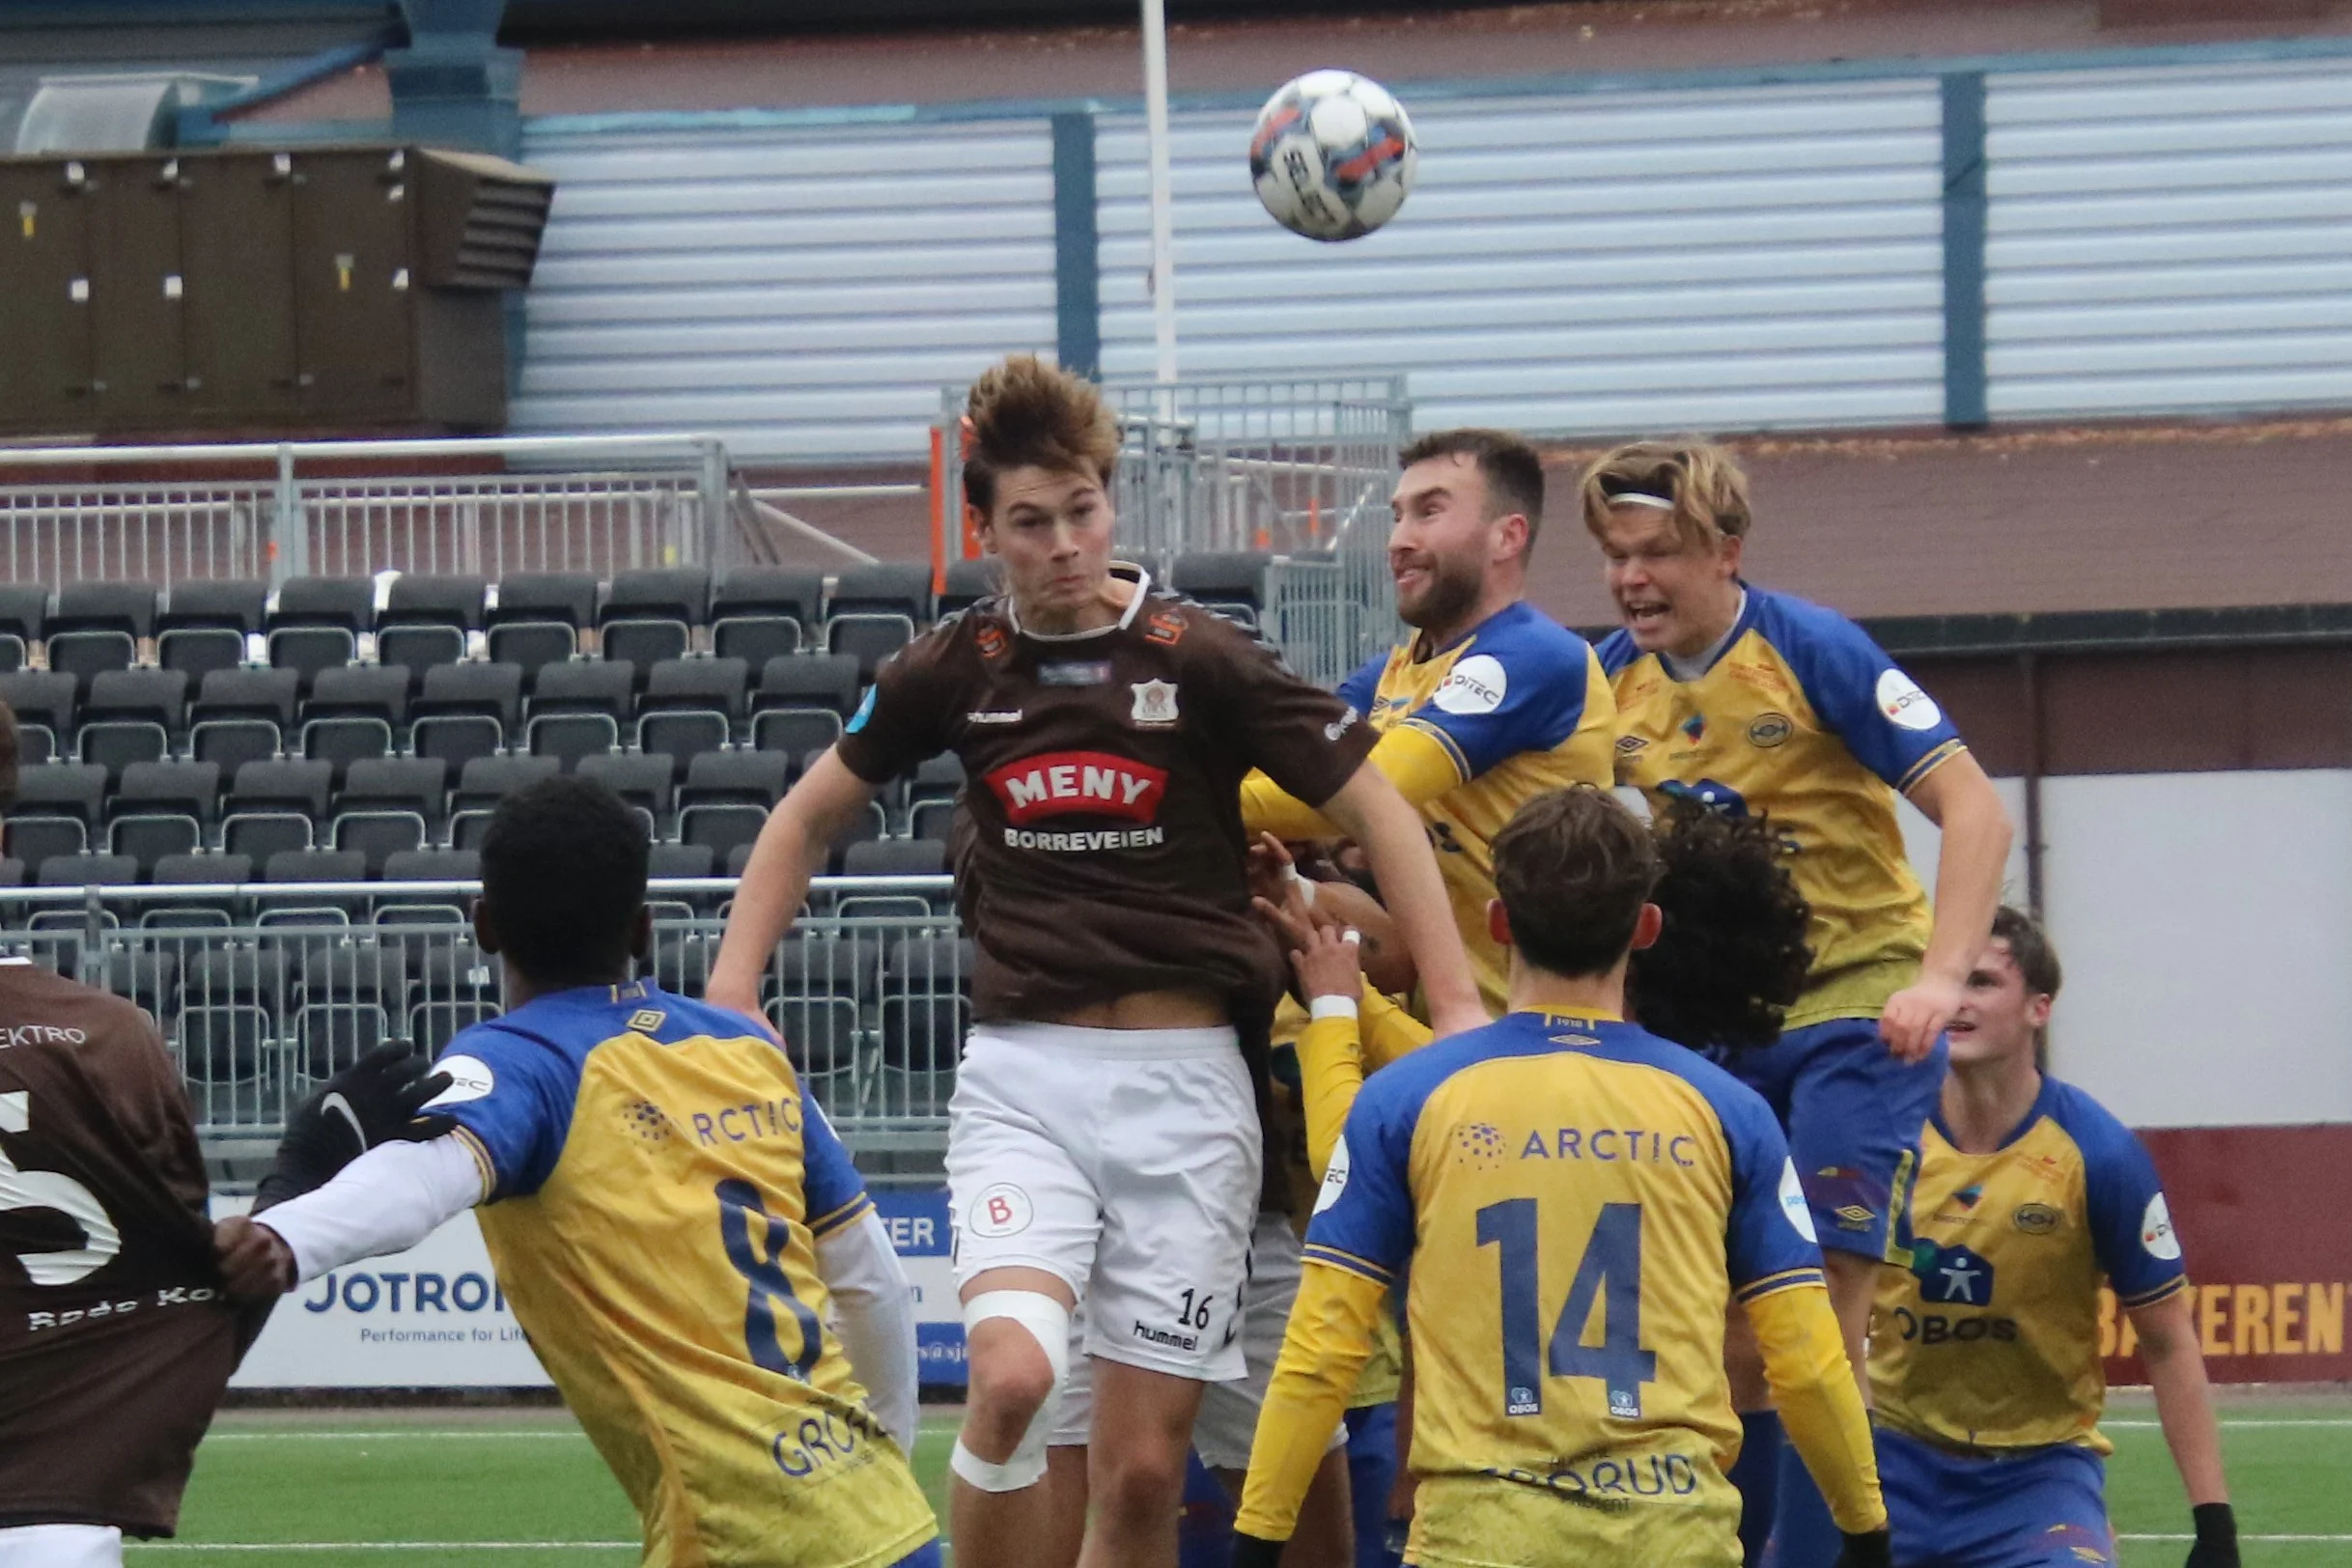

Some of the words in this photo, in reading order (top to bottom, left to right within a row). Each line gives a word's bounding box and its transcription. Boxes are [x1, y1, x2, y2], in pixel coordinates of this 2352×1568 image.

[1453, 674, 1500, 706] DITEC
[1004, 765, 1153, 809] MENY
[1003, 826, 1164, 852] BORREVEIEN
[691, 1096, 800, 1147] RCTIC
[1520, 1128, 1695, 1168] ARCTIC
[988, 1196, 1013, 1225] B
[881, 1217, 936, 1247] ER
[714, 1179, 823, 1379] 8
[1178, 1287, 1214, 1330] 16
[1475, 1197, 1657, 1416] 14
[360, 1328, 465, 1343] Performance
[471, 1328, 493, 1342] for
[1133, 1320, 1199, 1351] hummel
